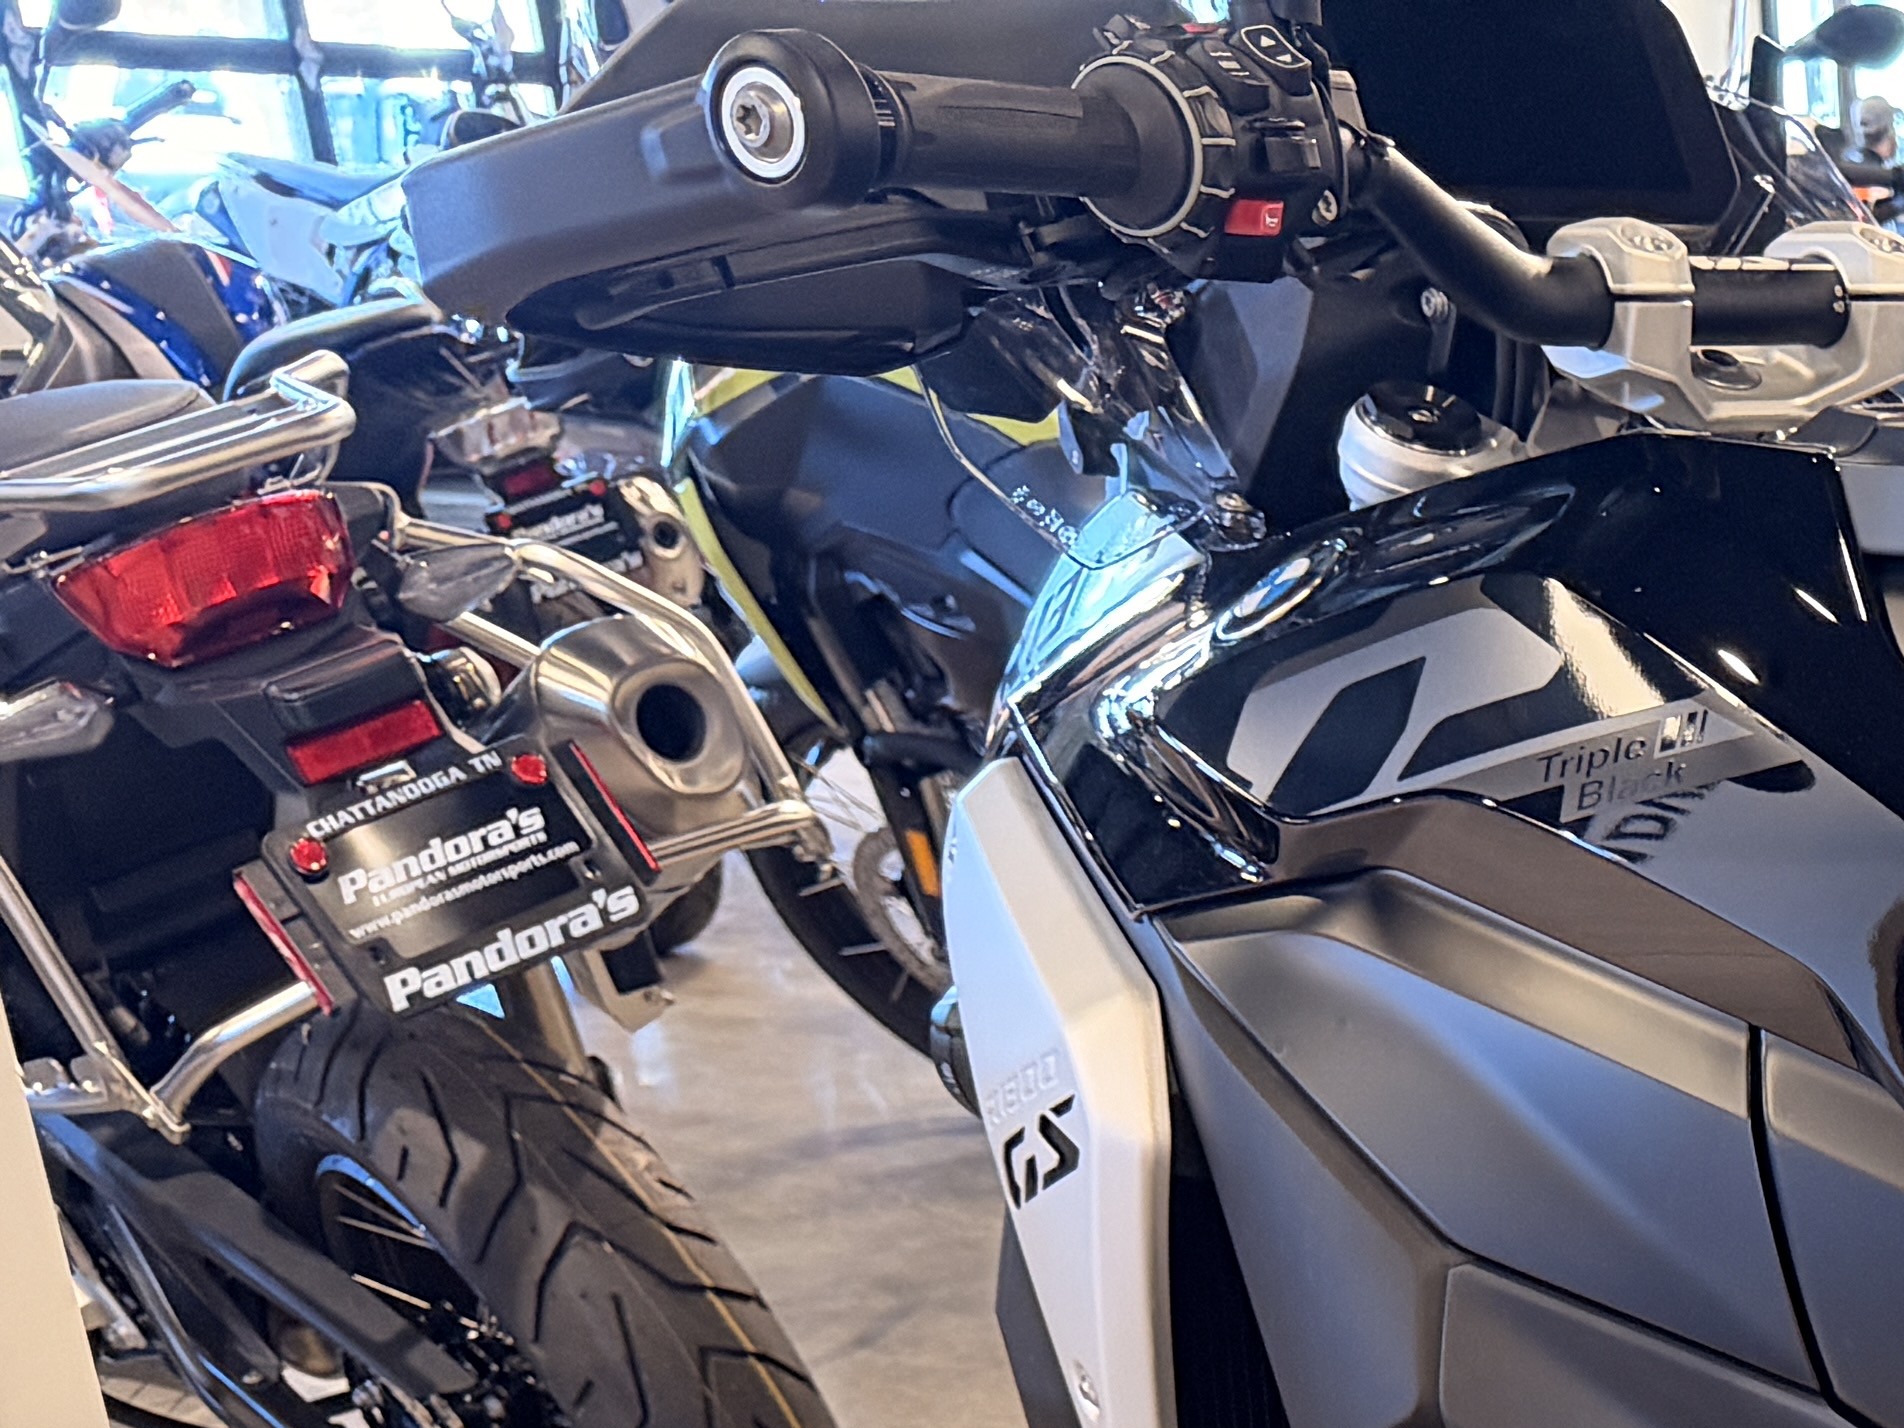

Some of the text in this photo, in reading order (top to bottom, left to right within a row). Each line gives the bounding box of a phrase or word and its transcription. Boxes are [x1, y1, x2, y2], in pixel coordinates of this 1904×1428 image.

[306, 750, 503, 839] CHATTANOOGA TN
[1537, 735, 1647, 783] Triple
[1577, 760, 1688, 812] Black
[338, 805, 546, 905] Pandora's
[348, 840, 581, 939] www.pandorasmotorsports.com
[383, 885, 640, 1013] Pandora's
[1003, 1093, 1081, 1210] GS
